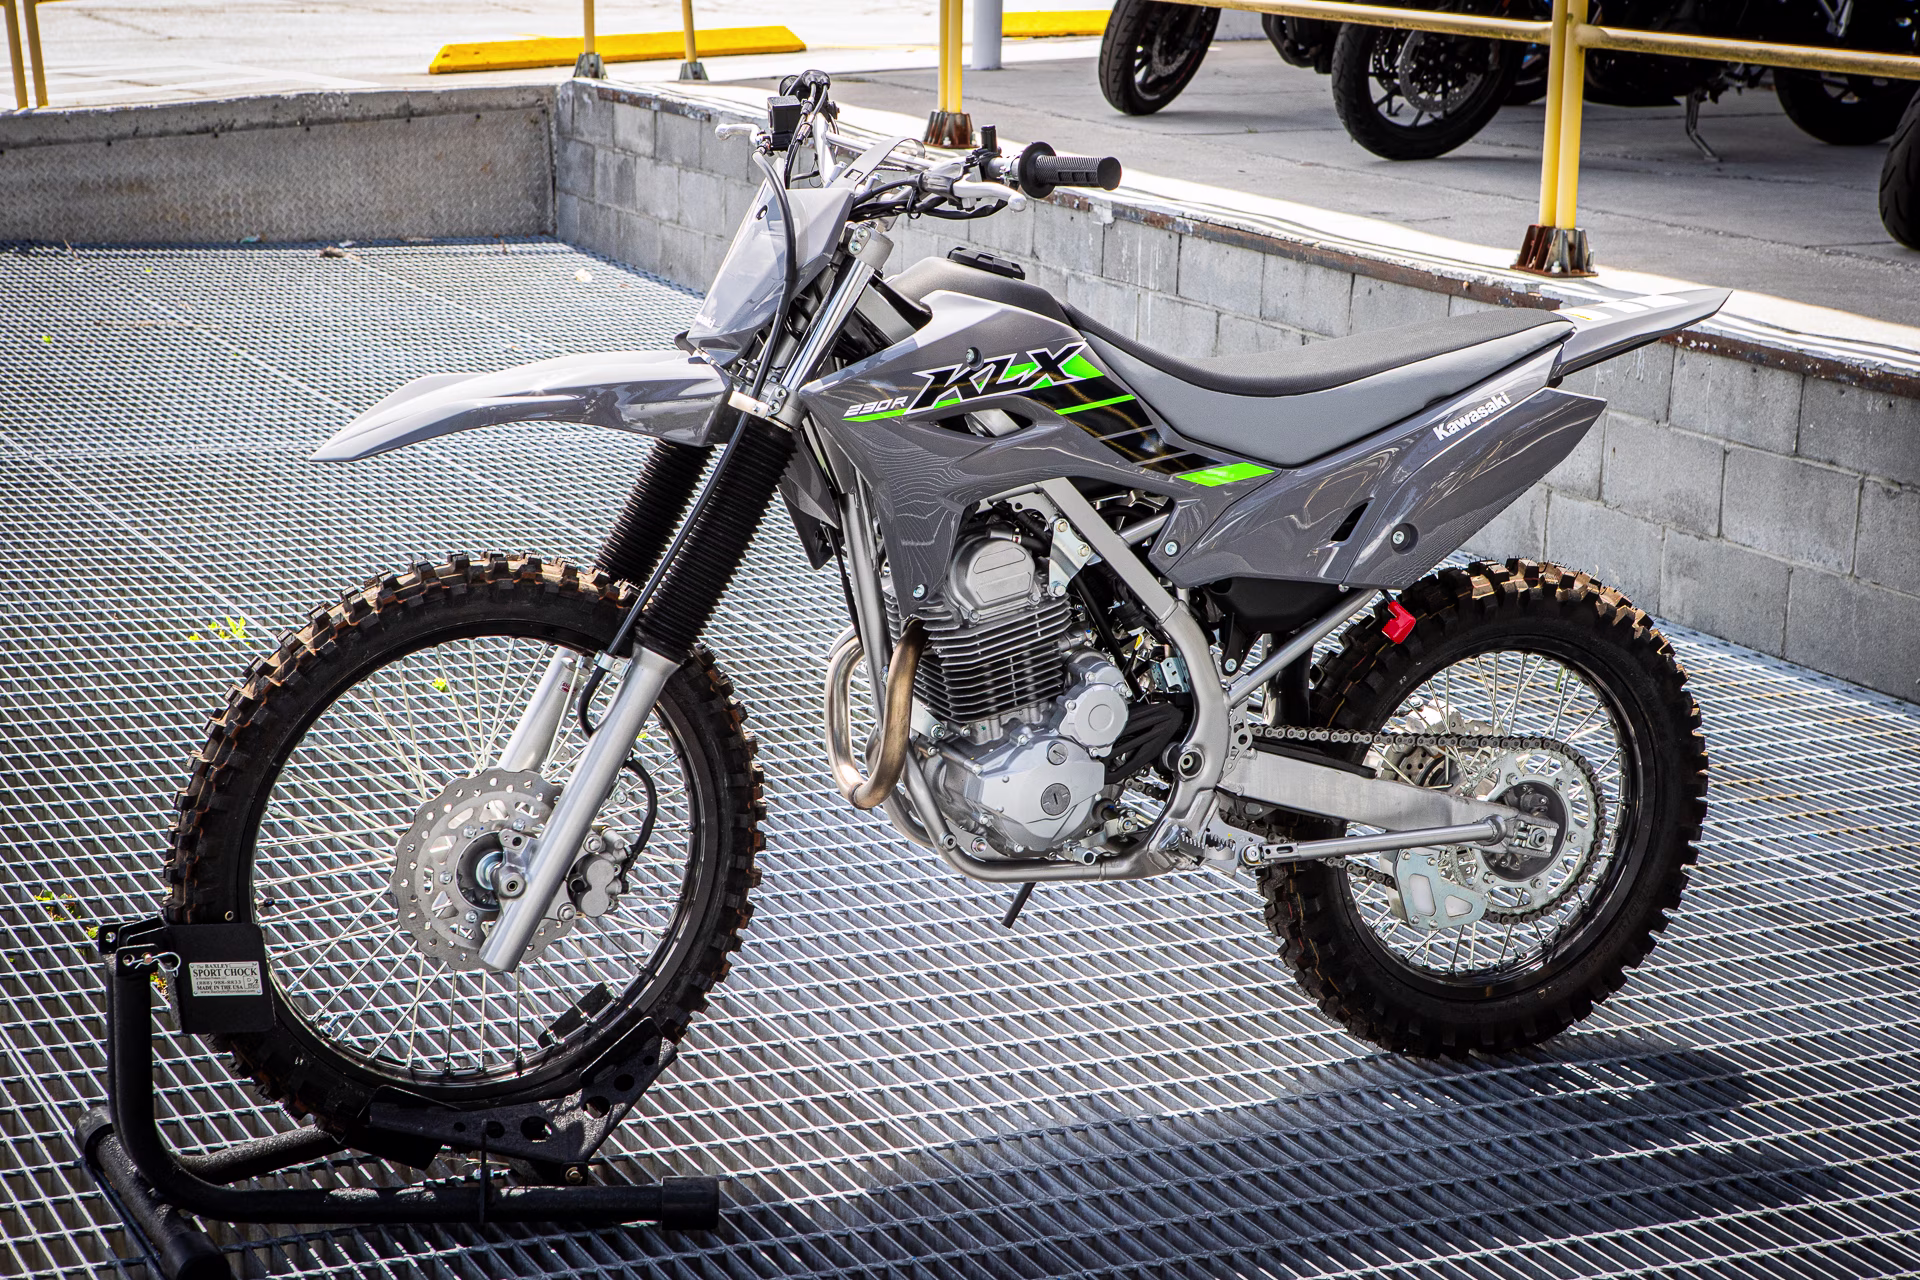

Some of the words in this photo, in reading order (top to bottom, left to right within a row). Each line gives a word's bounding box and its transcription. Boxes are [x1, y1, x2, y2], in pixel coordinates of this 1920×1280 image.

[904, 341, 1088, 415] KLX
[843, 396, 908, 417] 230R
[1432, 391, 1511, 441] Kawasaki
[193, 968, 222, 977] SPORT
[224, 967, 258, 976] CHOCK
